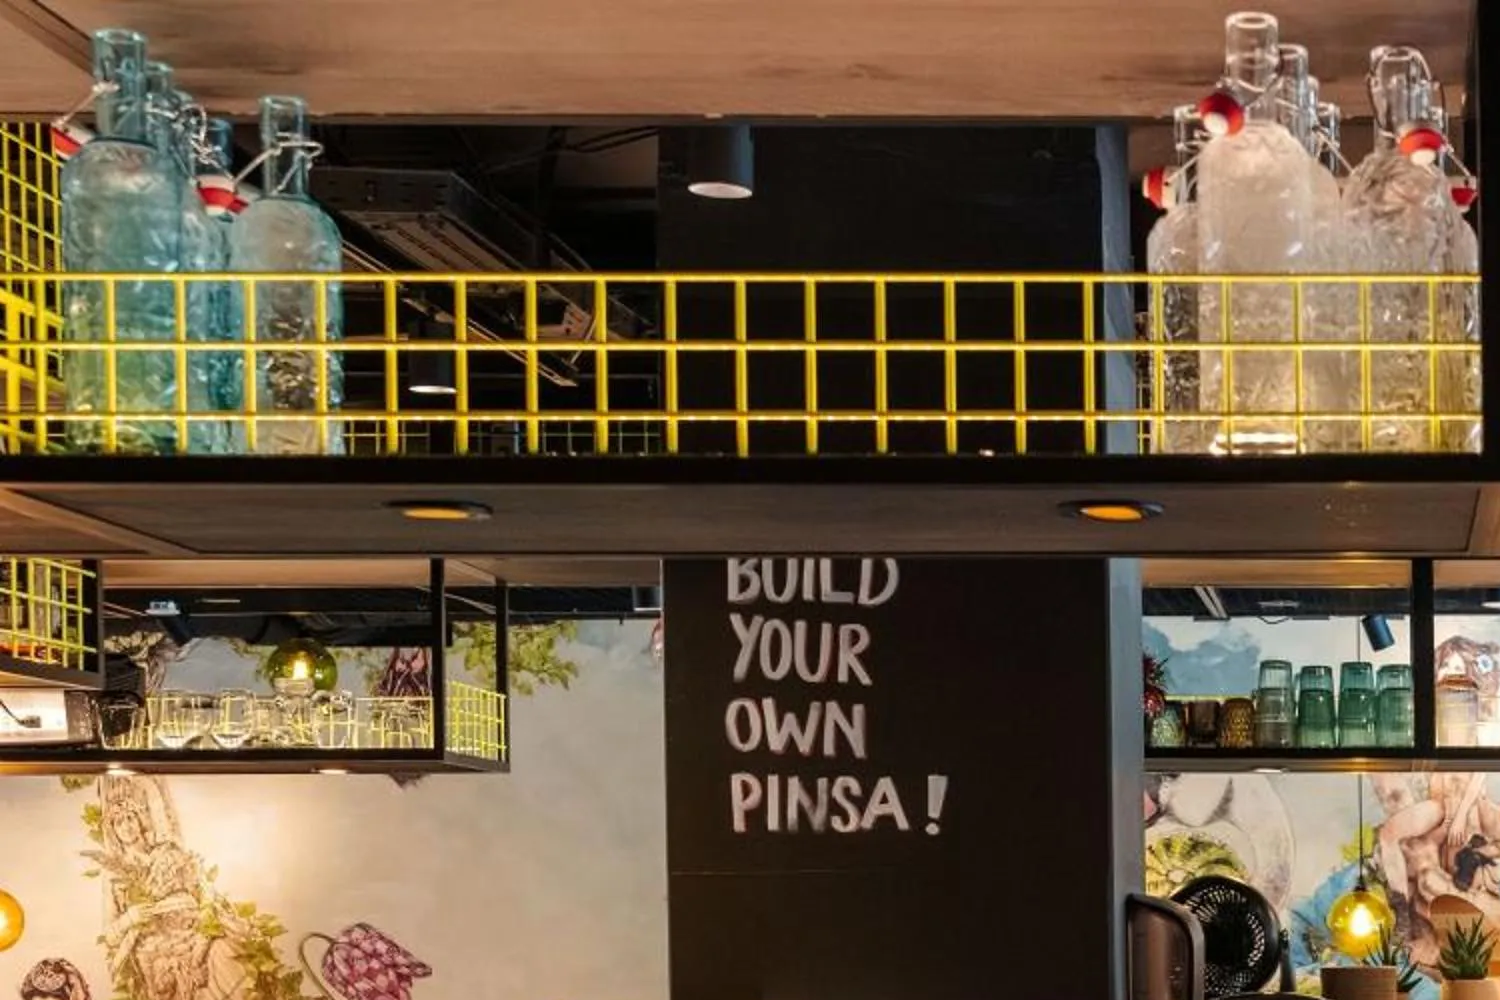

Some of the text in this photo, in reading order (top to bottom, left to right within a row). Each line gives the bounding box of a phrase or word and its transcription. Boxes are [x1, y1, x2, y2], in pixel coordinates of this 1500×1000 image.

[727, 557, 900, 605] BUILD
[729, 612, 873, 686] YOUR
[725, 697, 867, 759] OWN
